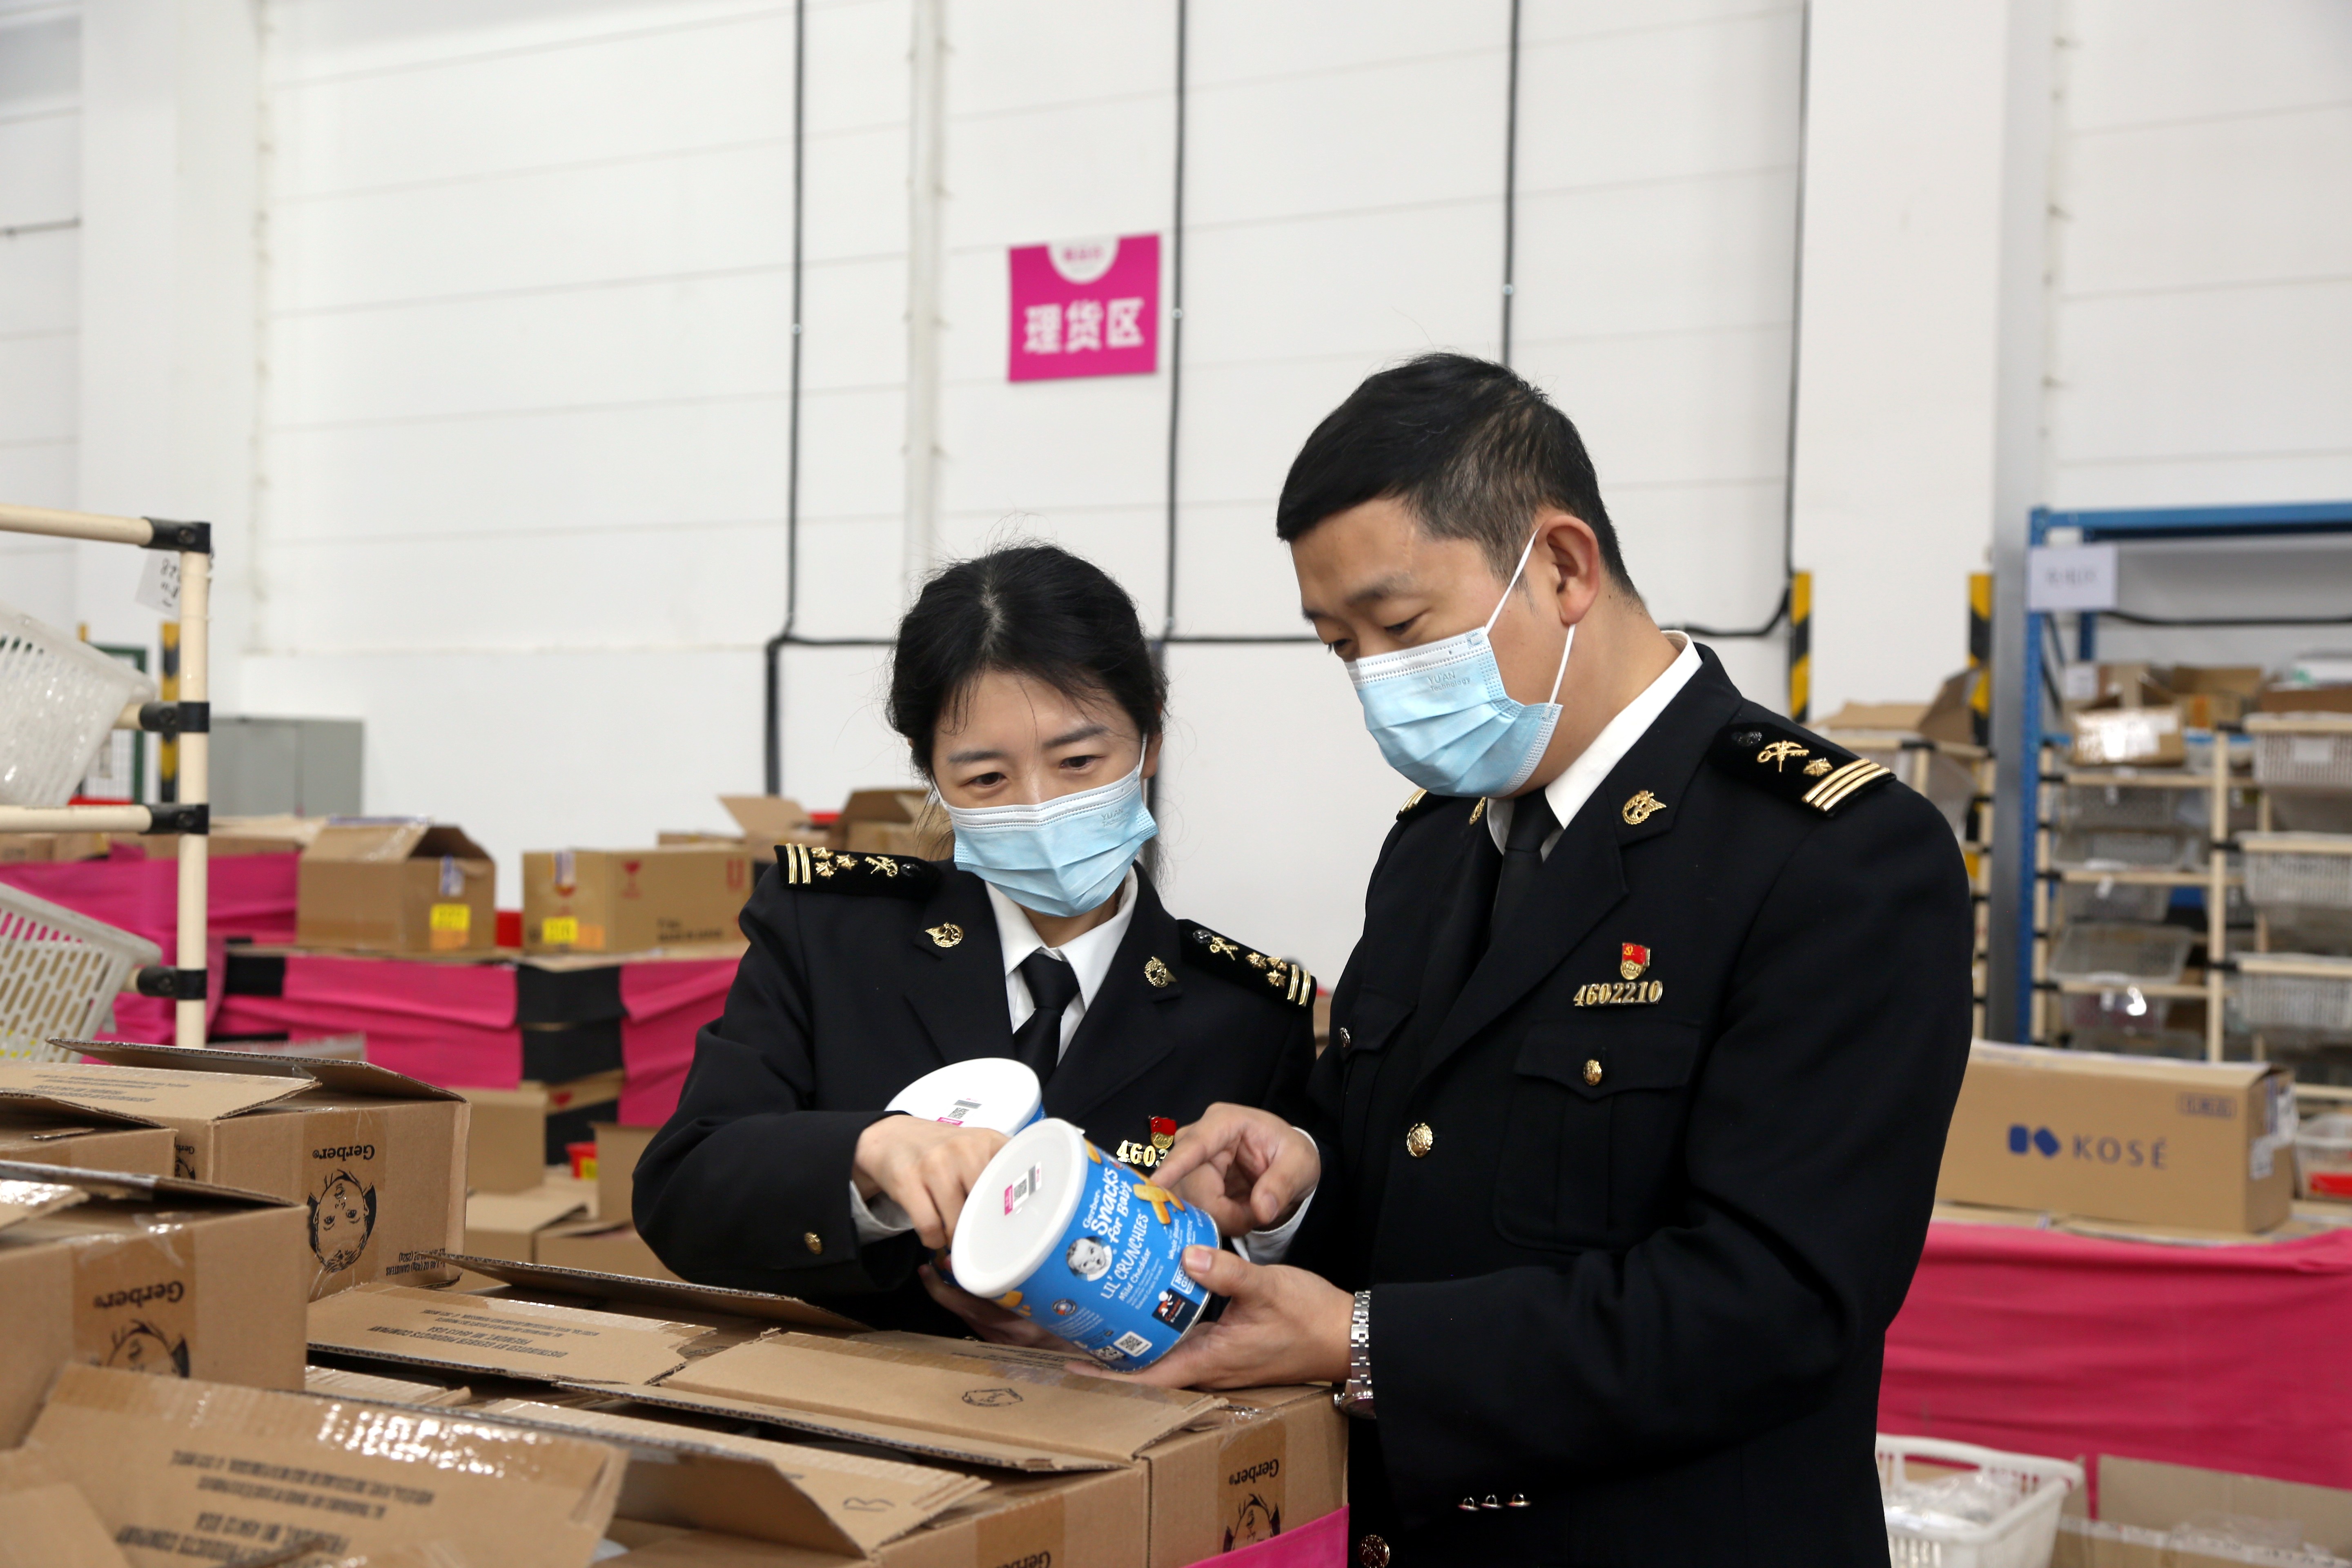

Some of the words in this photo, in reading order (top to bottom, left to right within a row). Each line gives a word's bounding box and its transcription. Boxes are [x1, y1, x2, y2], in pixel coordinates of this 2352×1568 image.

[1024, 296, 1145, 354] 理货区
[1430, 677, 1471, 693] Technology
[1573, 980, 1663, 1007] 4602210
[2073, 1133, 2169, 1170] KOSÉ
[1107, 1216, 1123, 1244] for
[1116, 1180, 1132, 1218] Baby
[386, 1264, 410, 1276] CANISTERS
[1118, 1282, 1134, 1301] Mild
[1130, 1247, 1152, 1284] Cheddar
[1175, 1266, 1184, 1285] NO
[409, 1332, 460, 1343] PRODUCTS
[456, 1338, 497, 1348] GERBER
